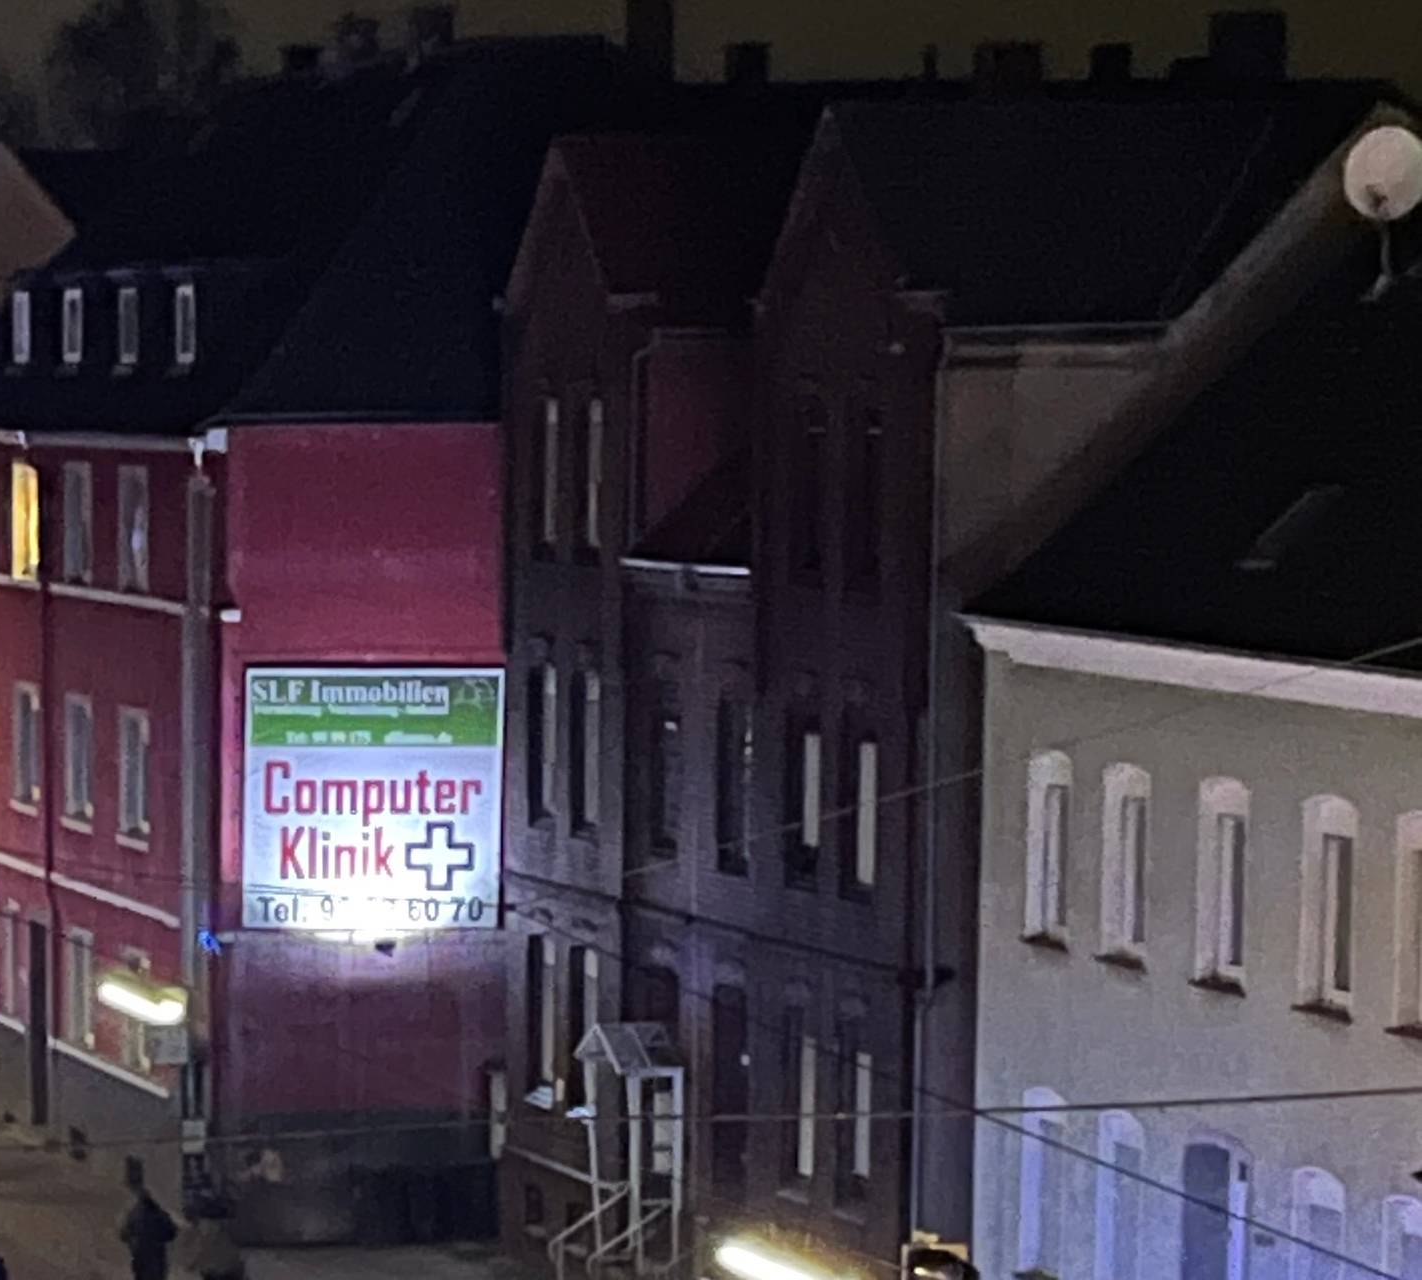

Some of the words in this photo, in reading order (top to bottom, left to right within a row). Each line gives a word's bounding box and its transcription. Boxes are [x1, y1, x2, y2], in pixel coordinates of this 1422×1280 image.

[252, 679, 305, 703] SLF
[309, 679, 450, 704] Immobilien
[264, 760, 482, 827] Computer
[279, 826, 395, 880] Klinik
[256, 895, 307, 923] Tel.
[450, 896, 485, 923] 70
